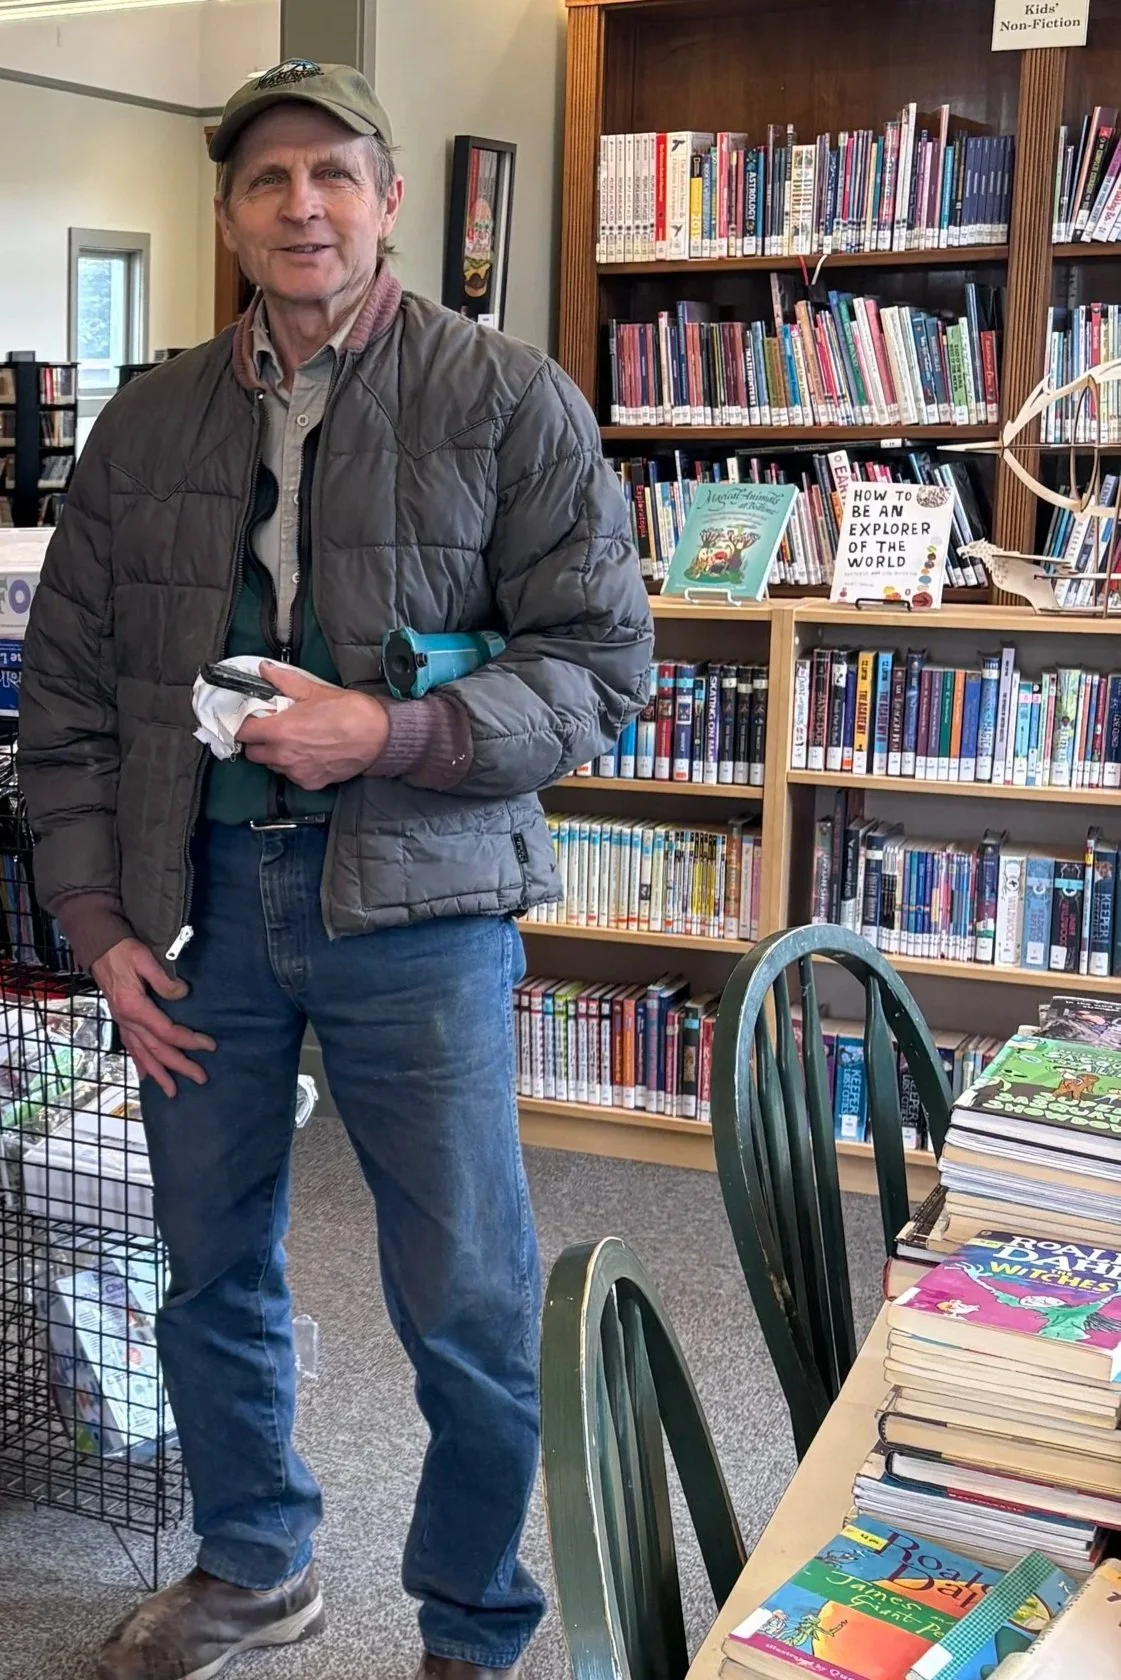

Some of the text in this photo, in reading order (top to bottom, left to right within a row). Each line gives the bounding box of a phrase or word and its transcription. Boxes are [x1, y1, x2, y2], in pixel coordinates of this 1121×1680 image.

[1025, 3, 1059, 15] Kids'
[1000, 17, 1081, 31] Non-Fiction
[748, 172, 757, 220] ASTROLOGY
[854, 490, 912, 501] HOW TO
[852, 505, 903, 517] BE AN
[849, 522, 930, 536] EXPLORER
[848, 541, 906, 553] OF THE
[848, 557, 906, 568] WORLD
[857, 702, 868, 735] ACADEMY
[1098, 893, 1111, 937] KEEPER
[843, 1069, 851, 1088] LOST
[849, 1069, 862, 1113] KEEPER
[990, 1261, 1116, 1292] WITCHES
[825, 1570, 922, 1611] James
[848, 1594, 945, 1639] Giant Pe
